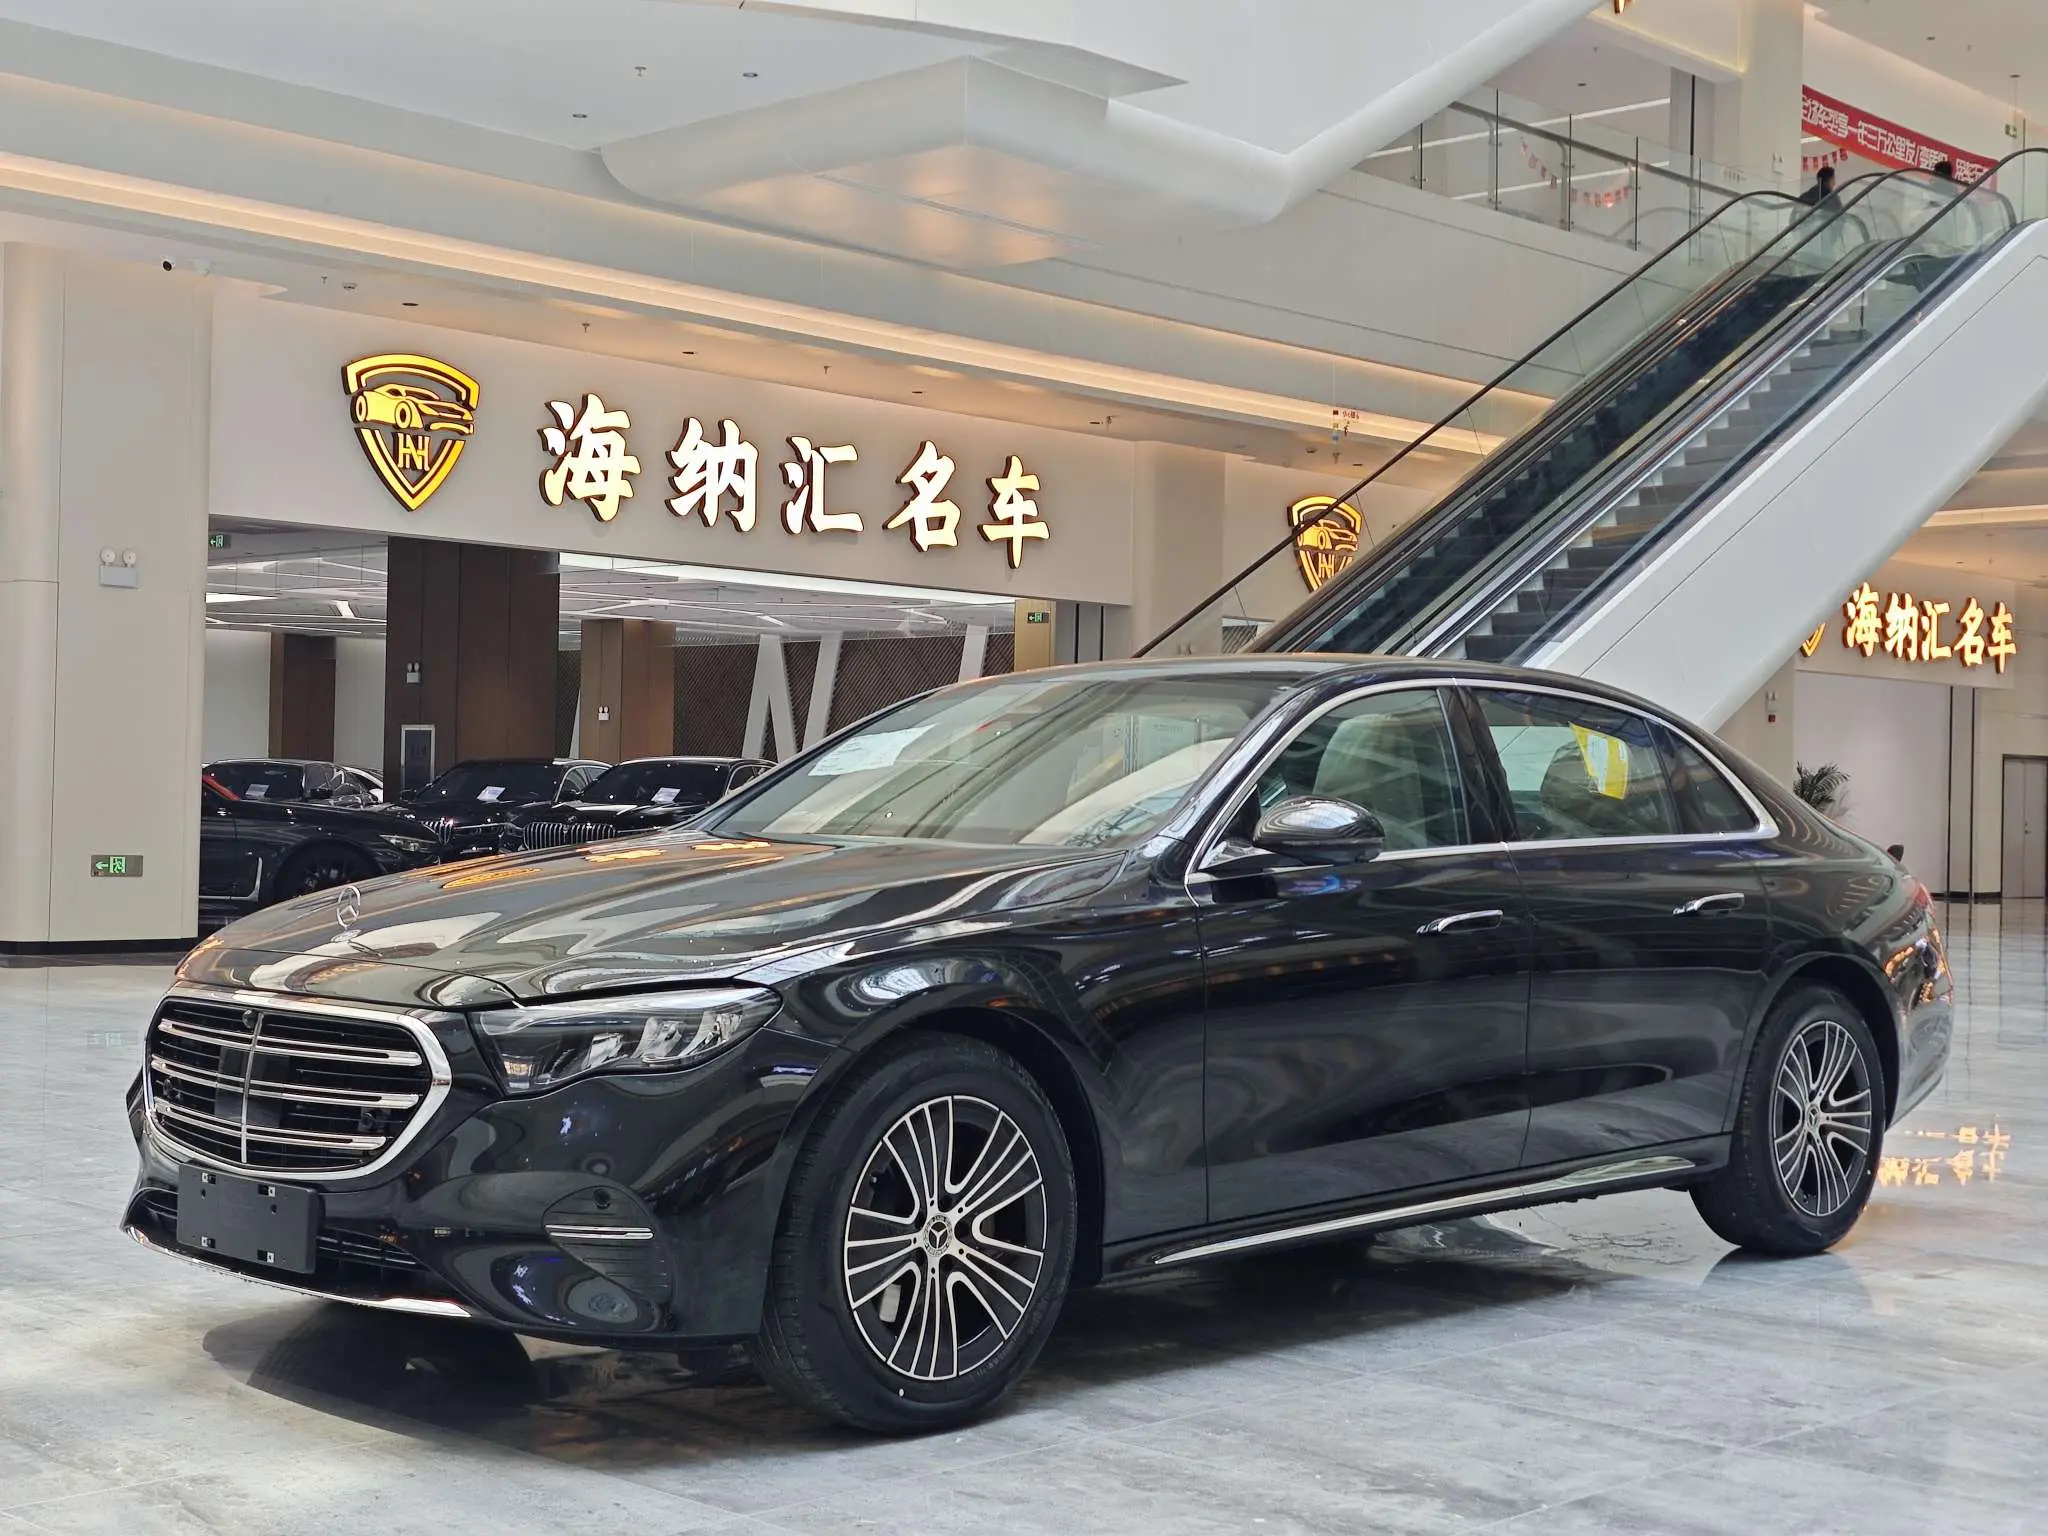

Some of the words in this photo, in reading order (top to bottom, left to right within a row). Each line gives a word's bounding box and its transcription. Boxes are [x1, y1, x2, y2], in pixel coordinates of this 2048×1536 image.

[538, 393, 1050, 569] 海纳汇名车
[1843, 582, 2017, 674] 海纳汇名车
